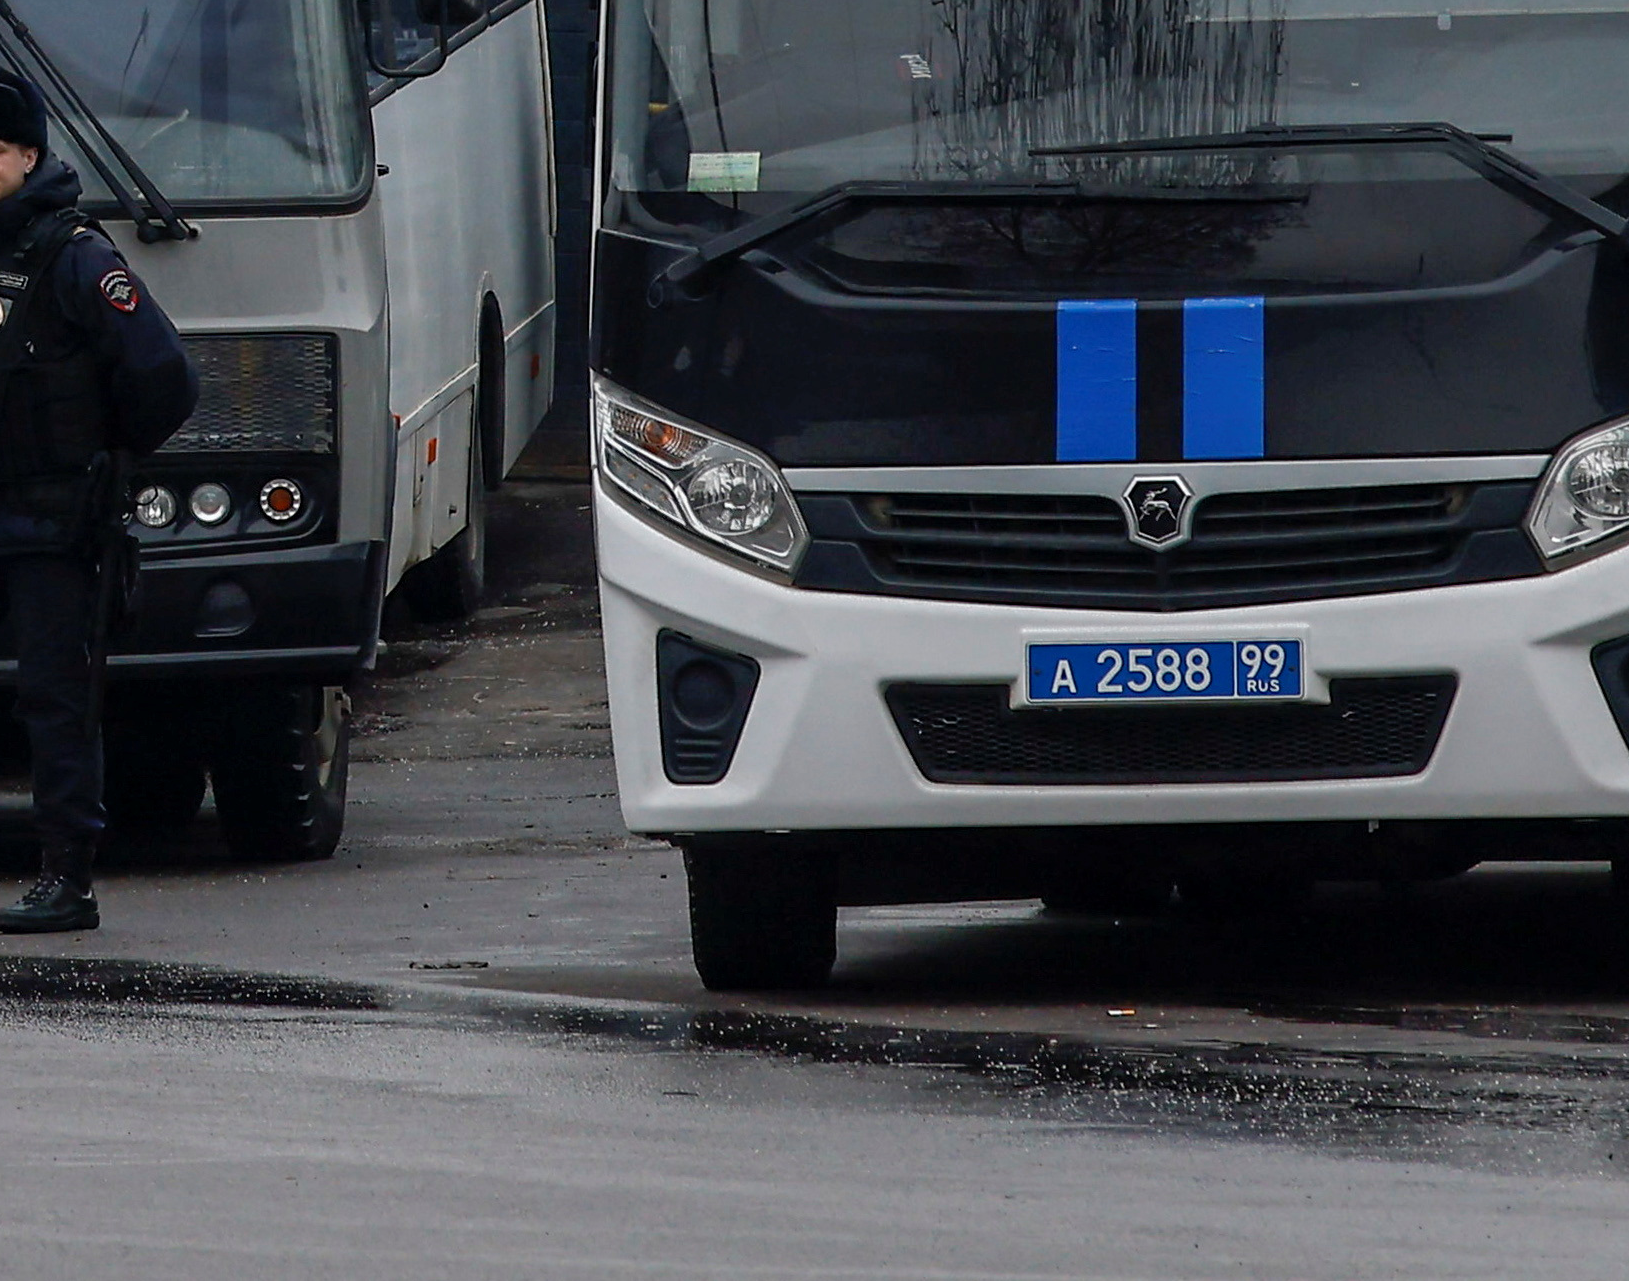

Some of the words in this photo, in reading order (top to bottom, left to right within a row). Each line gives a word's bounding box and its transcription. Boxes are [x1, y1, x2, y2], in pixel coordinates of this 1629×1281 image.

[1051, 660, 1077, 694] А
[1097, 648, 1212, 693] 2588
[1241, 644, 1285, 679] 99
[1246, 679, 1280, 693] RUS
